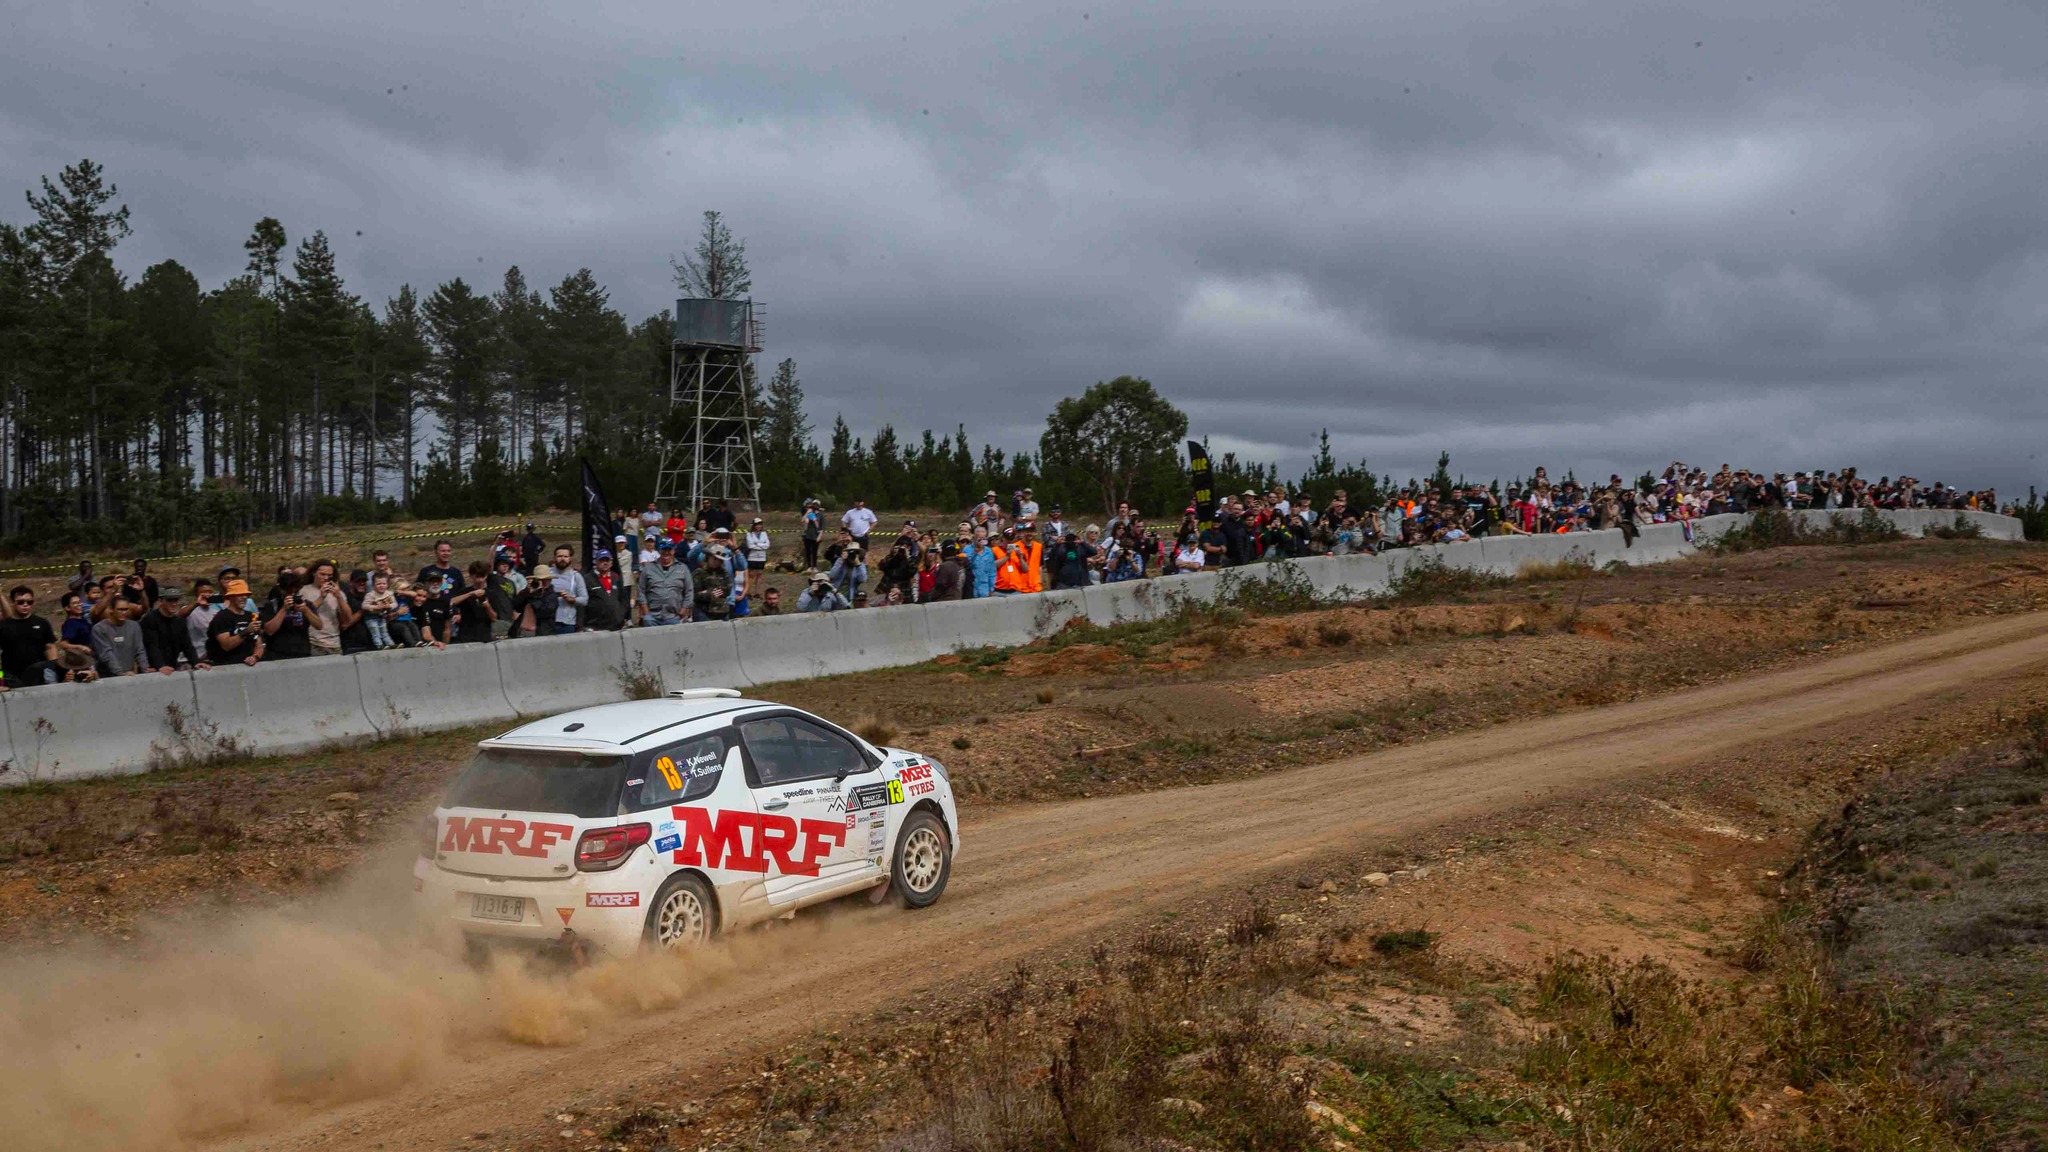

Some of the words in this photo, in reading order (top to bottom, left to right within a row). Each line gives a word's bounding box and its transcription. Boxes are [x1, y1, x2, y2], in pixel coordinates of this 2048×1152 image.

[656, 756, 683, 791] 13
[692, 763, 723, 778] T.Sullens
[898, 764, 932, 785] MRF
[783, 788, 814, 799] speedline
[887, 779, 904, 804] 13
[909, 780, 935, 797] TYRES
[862, 799, 886, 808] CANBERRA
[439, 816, 574, 858] MRF
[671, 806, 847, 877] MRF
[589, 893, 637, 906] MRF
